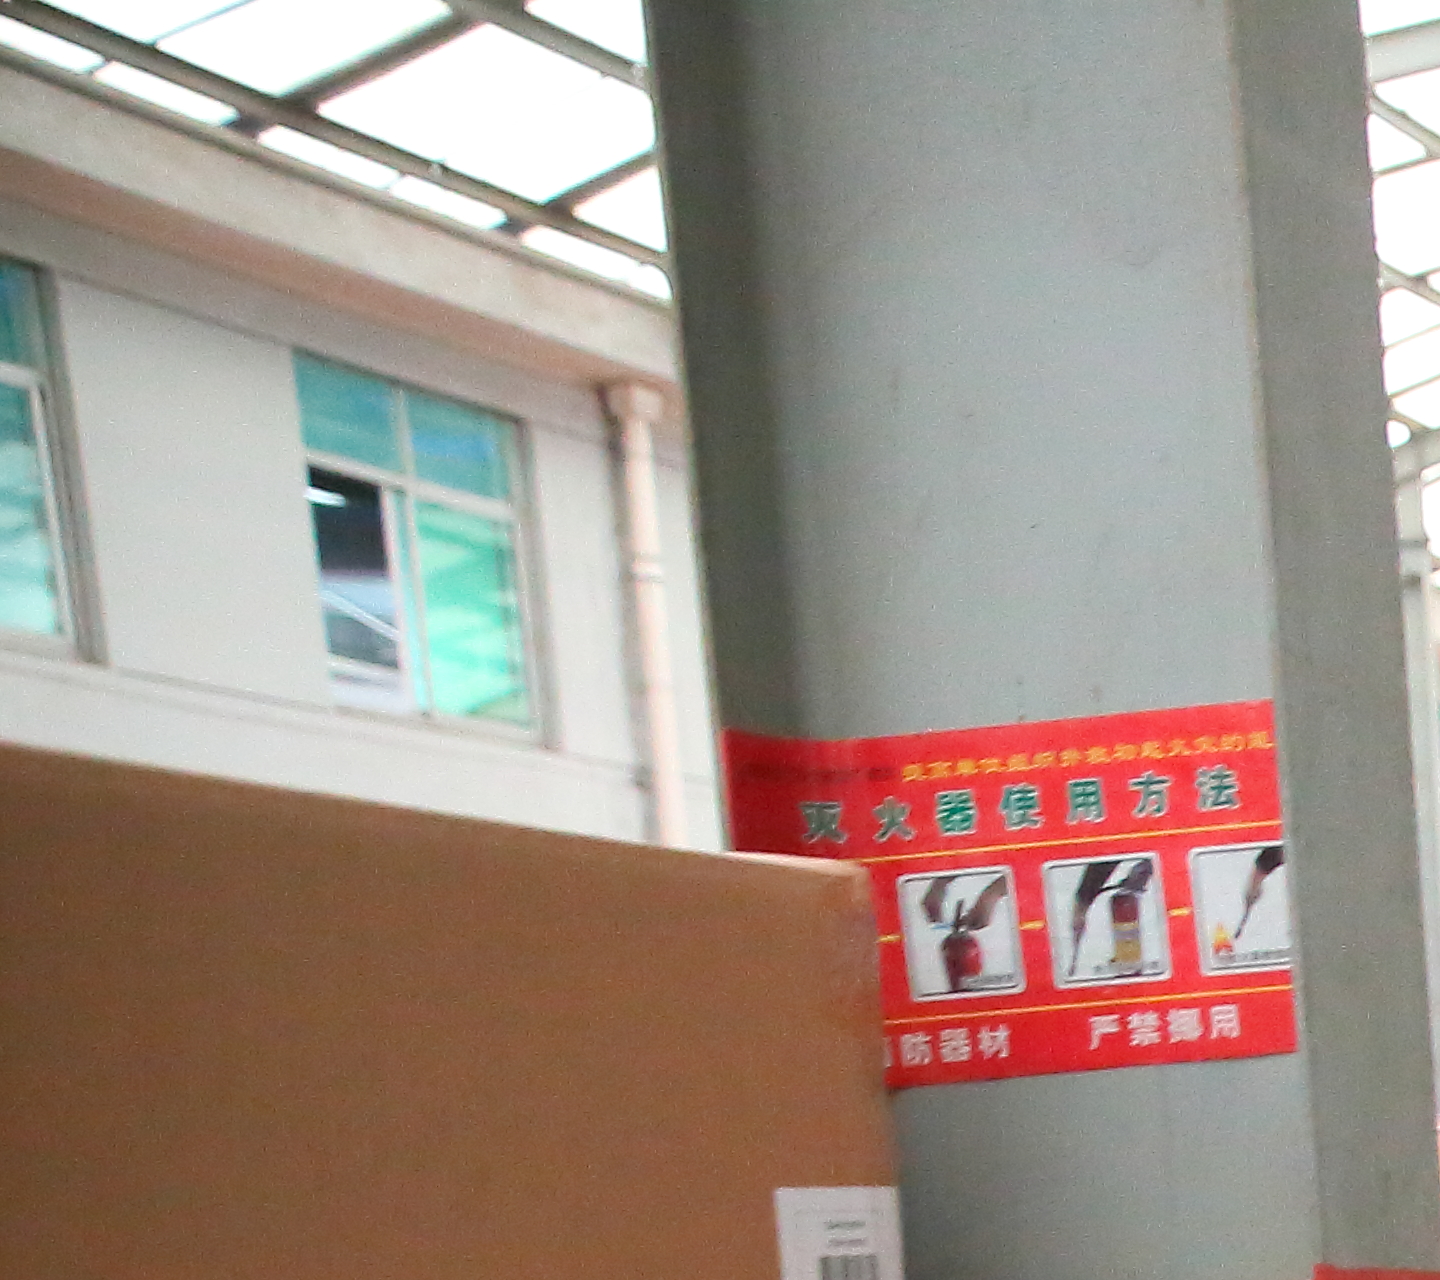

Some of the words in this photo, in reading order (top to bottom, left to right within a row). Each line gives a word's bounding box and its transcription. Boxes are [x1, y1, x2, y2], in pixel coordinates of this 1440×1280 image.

[800, 764, 1243, 846] 灭火器使用方法
[1088, 1003, 1243, 1051] 严禁挪用
